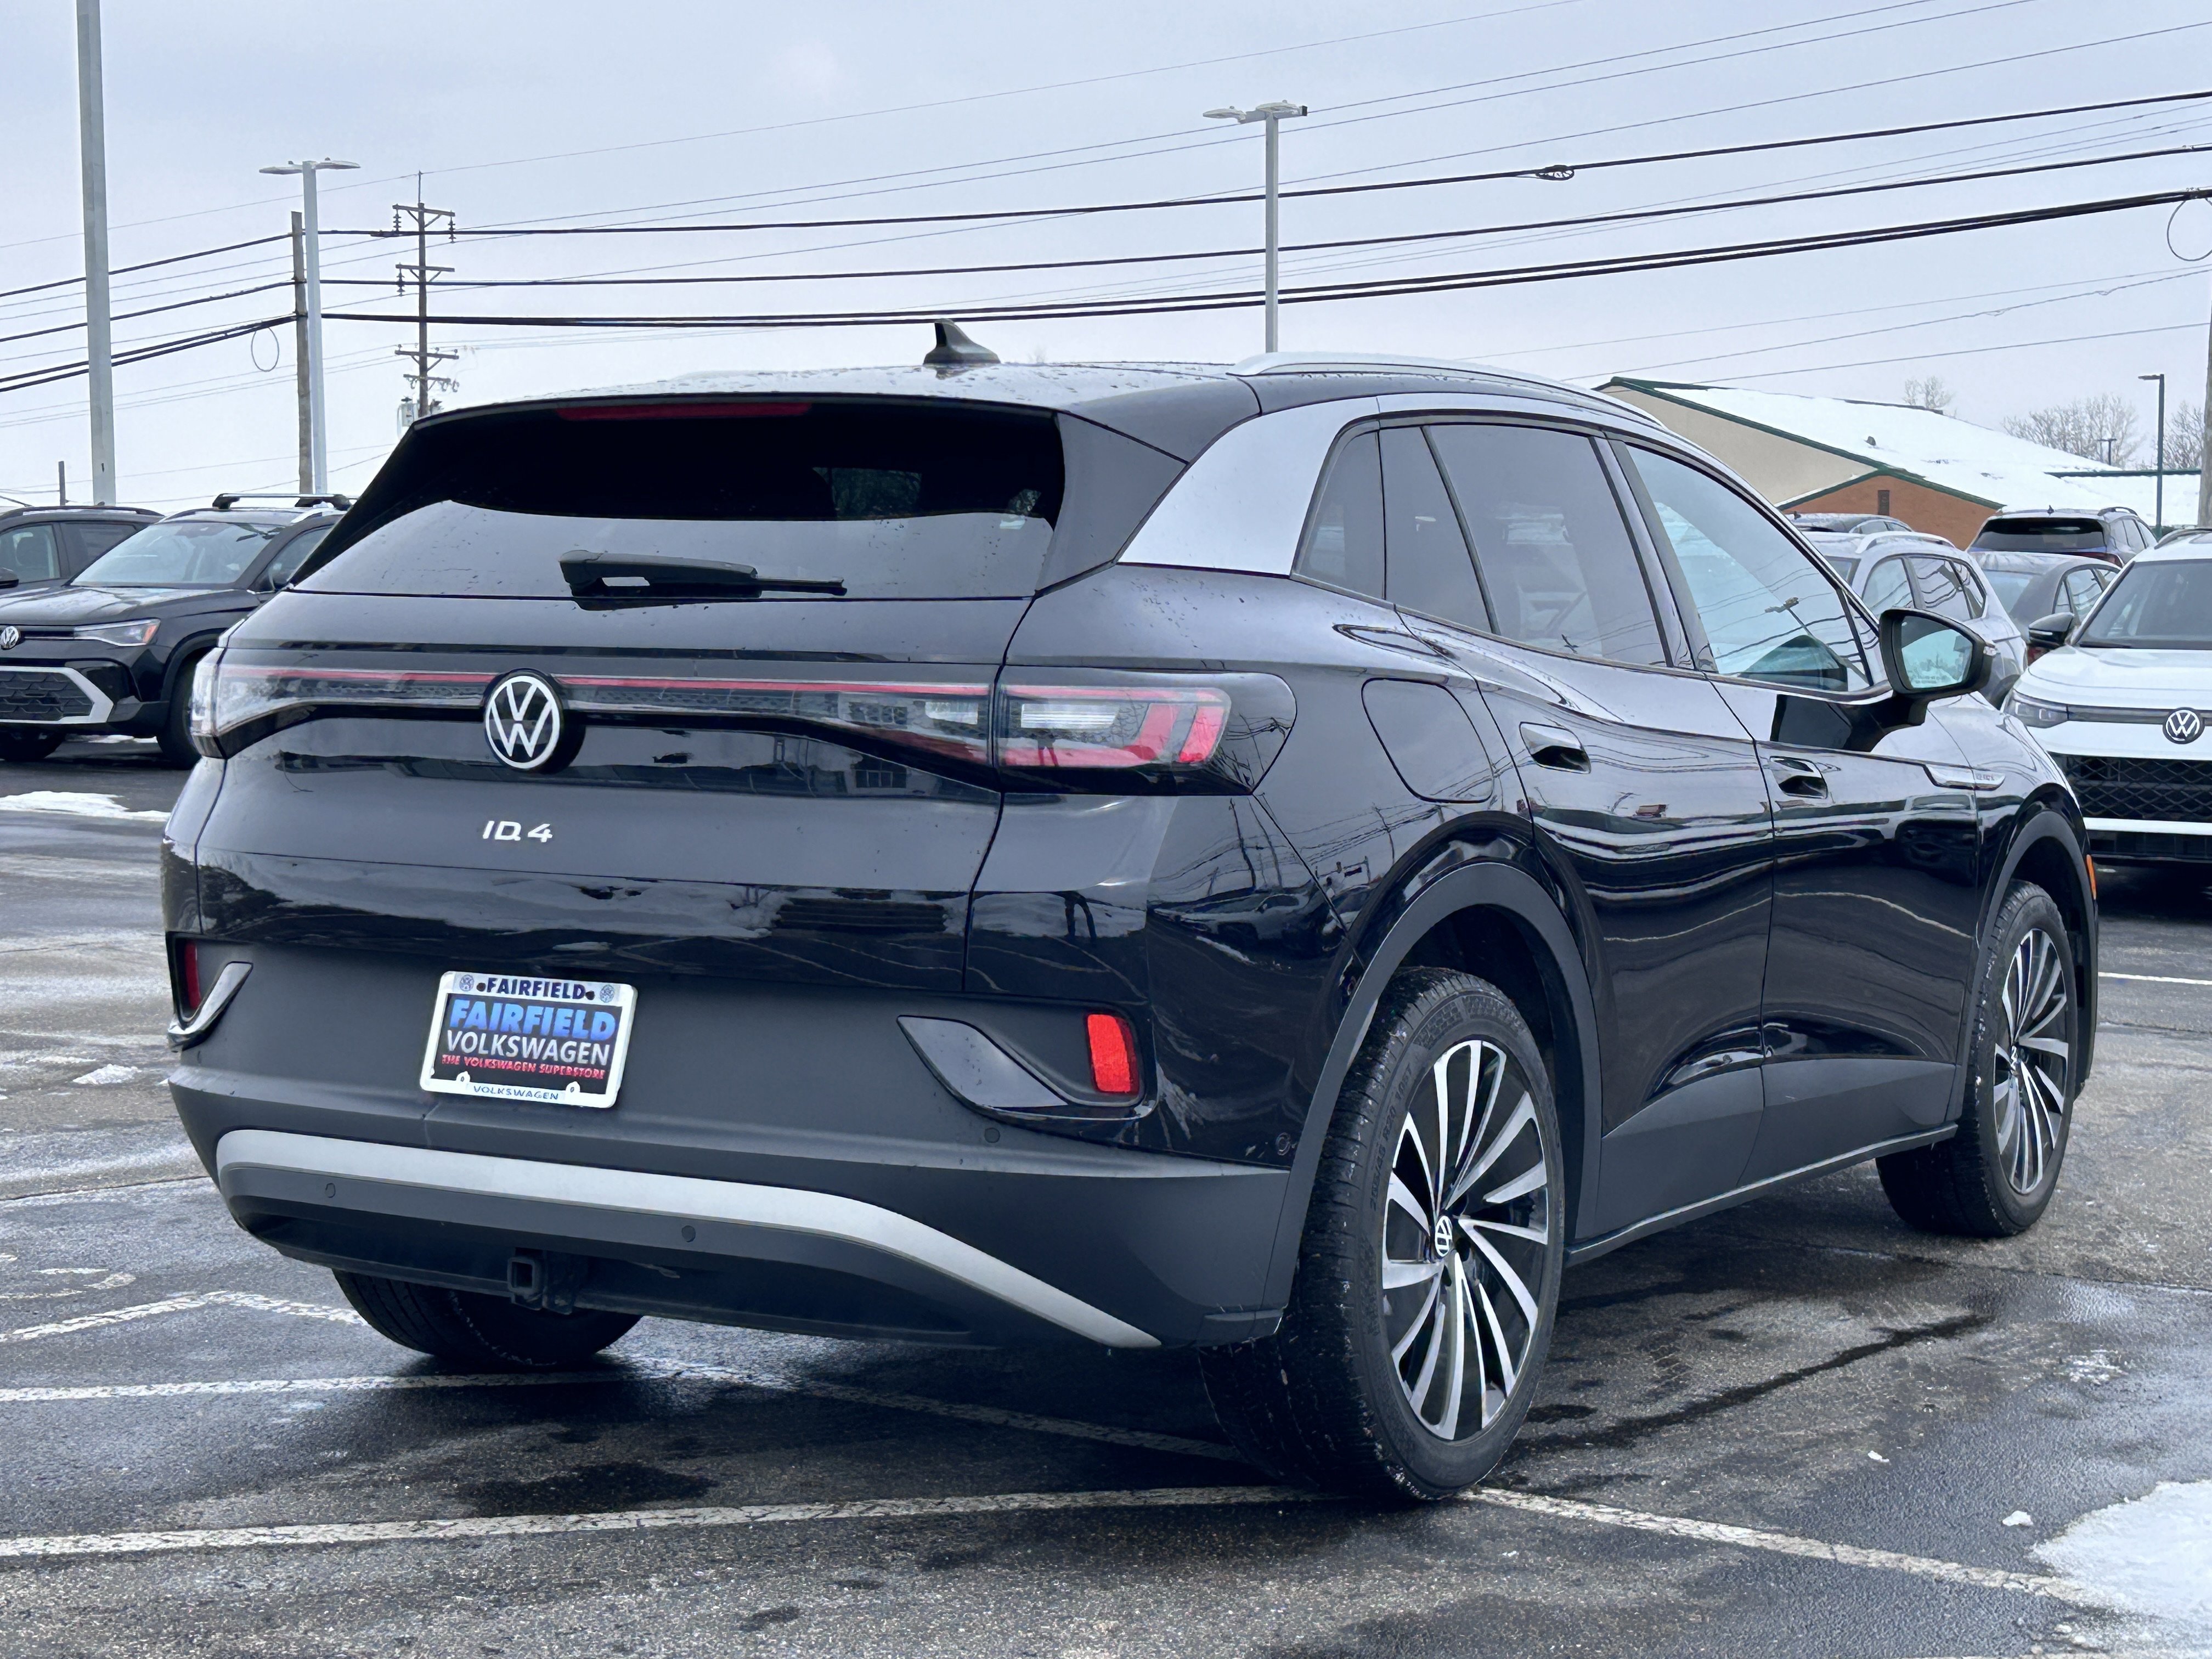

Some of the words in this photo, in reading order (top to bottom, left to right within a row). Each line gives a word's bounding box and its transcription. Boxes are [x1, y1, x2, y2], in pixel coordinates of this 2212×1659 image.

[488, 678, 556, 765] VW
[2166, 710, 2199, 740] VW
[487, 978, 585, 999] FAIRFIELD
[449, 998, 616, 1041] FAIRFIELD
[447, 1030, 611, 1066] VOLKSWAGEN
[442, 1054, 460, 1065] THE
[464, 1057, 536, 1073] VOLKSWAGEN
[539, 1063, 606, 1079] SUPERSTORE
[474, 1086, 558, 1100] VOLKSWAGEN
